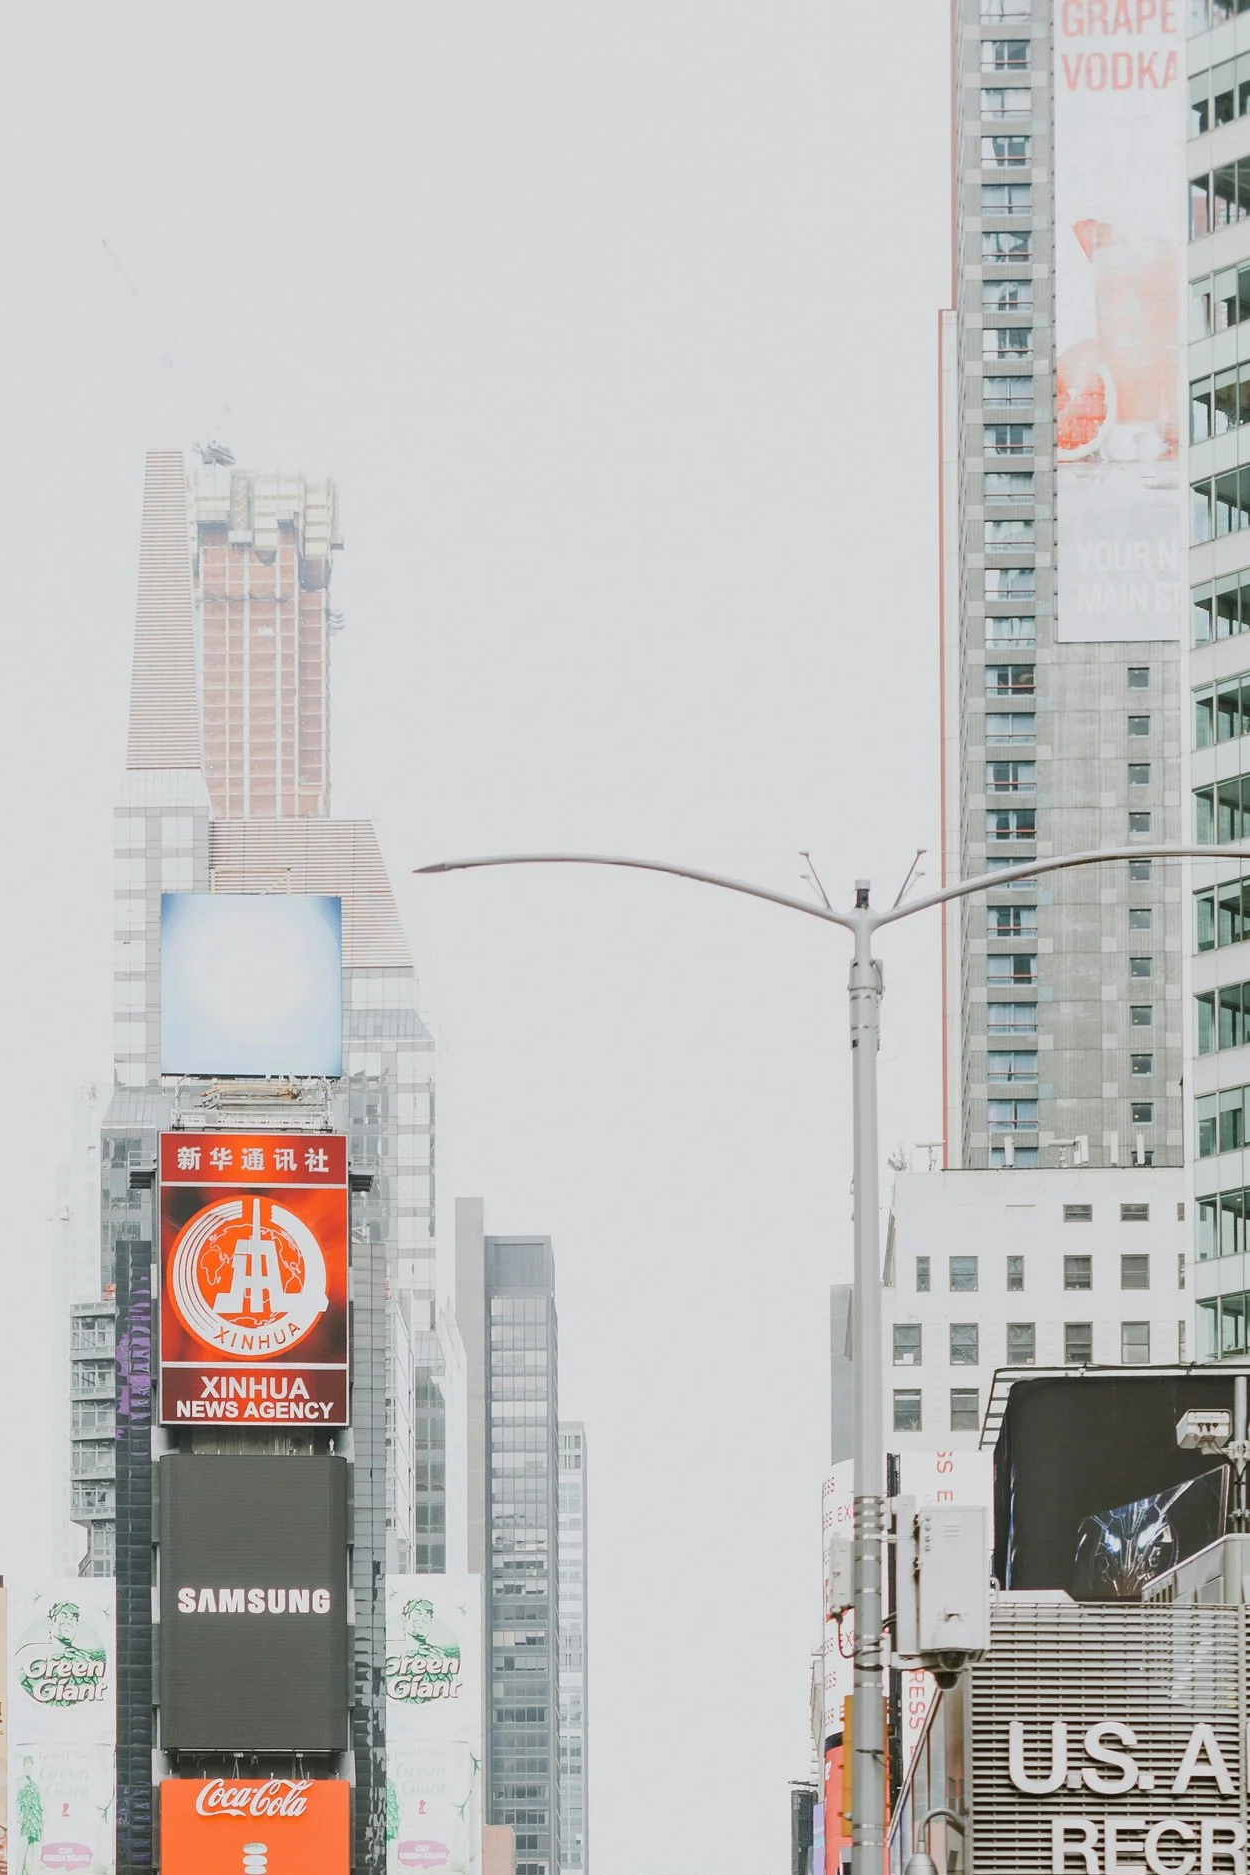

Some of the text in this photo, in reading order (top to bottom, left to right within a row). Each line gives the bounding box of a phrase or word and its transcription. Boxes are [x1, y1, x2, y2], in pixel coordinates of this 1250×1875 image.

[1061, 0, 1178, 37] GRAPE
[1061, 50, 1178, 92] VODKA
[176, 1145, 330, 1173] 新华通讯社
[213, 1321, 302, 1351] XINHUA
[200, 1375, 310, 1400] XINHUA
[176, 1400, 334, 1420] NEWS AGENCY
[177, 1586, 332, 1615] SAMSUNG
[23, 1656, 107, 1680] Green
[386, 1653, 463, 1678] Green
[33, 1677, 109, 1703] Giant
[387, 1675, 463, 1702] Giant
[1008, 1720, 1250, 1796] U.S. A
[195, 1778, 314, 1818] Coca-Cola
